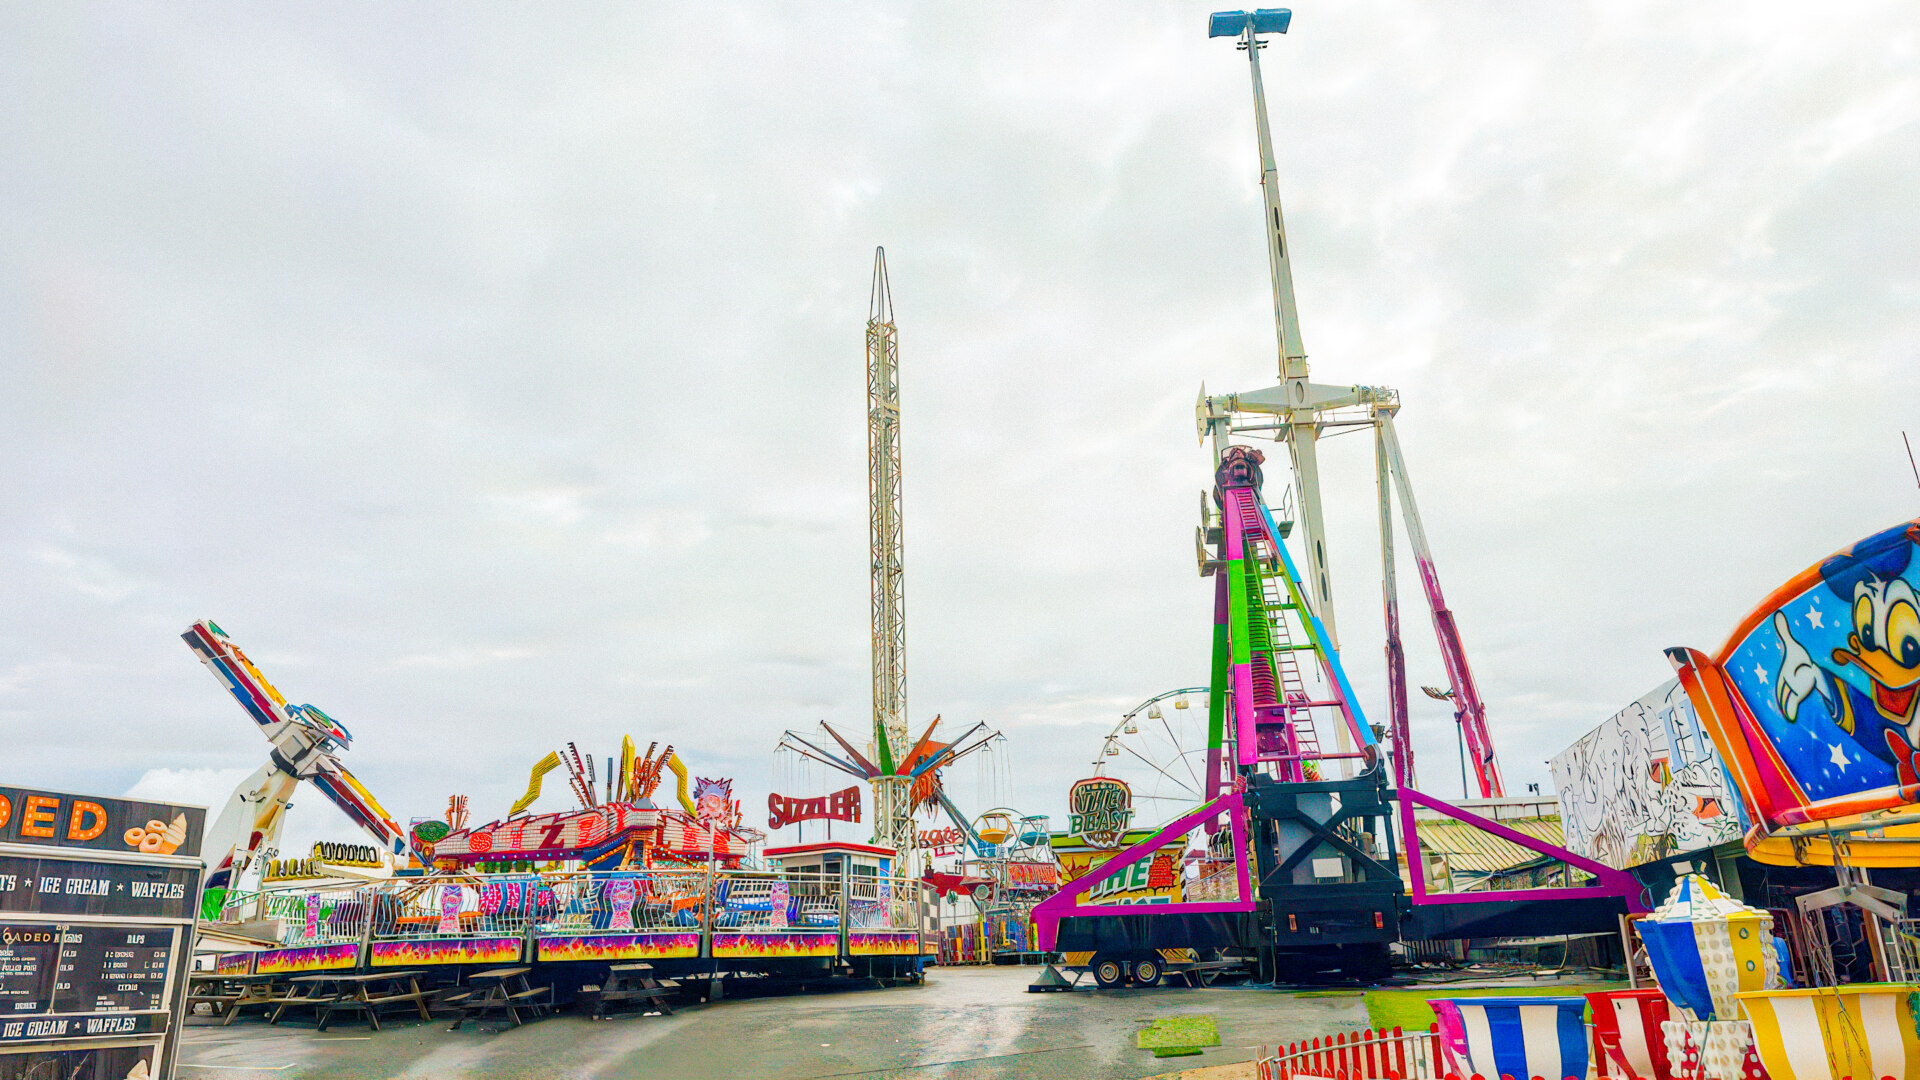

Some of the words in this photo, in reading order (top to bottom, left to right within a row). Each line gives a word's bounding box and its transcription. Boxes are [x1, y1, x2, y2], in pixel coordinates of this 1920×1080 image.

[768, 786, 860, 829] SIZZLER
[1067, 808, 1136, 838] BEAST
[39, 876, 61, 893] ICE
[66, 879, 110, 895] CREAM
[131, 881, 185, 899] WAFFLES
[3, 1023, 24, 1037] ICE
[27, 1020, 69, 1036] CREAM
[87, 1017, 137, 1033] WAFFLES
